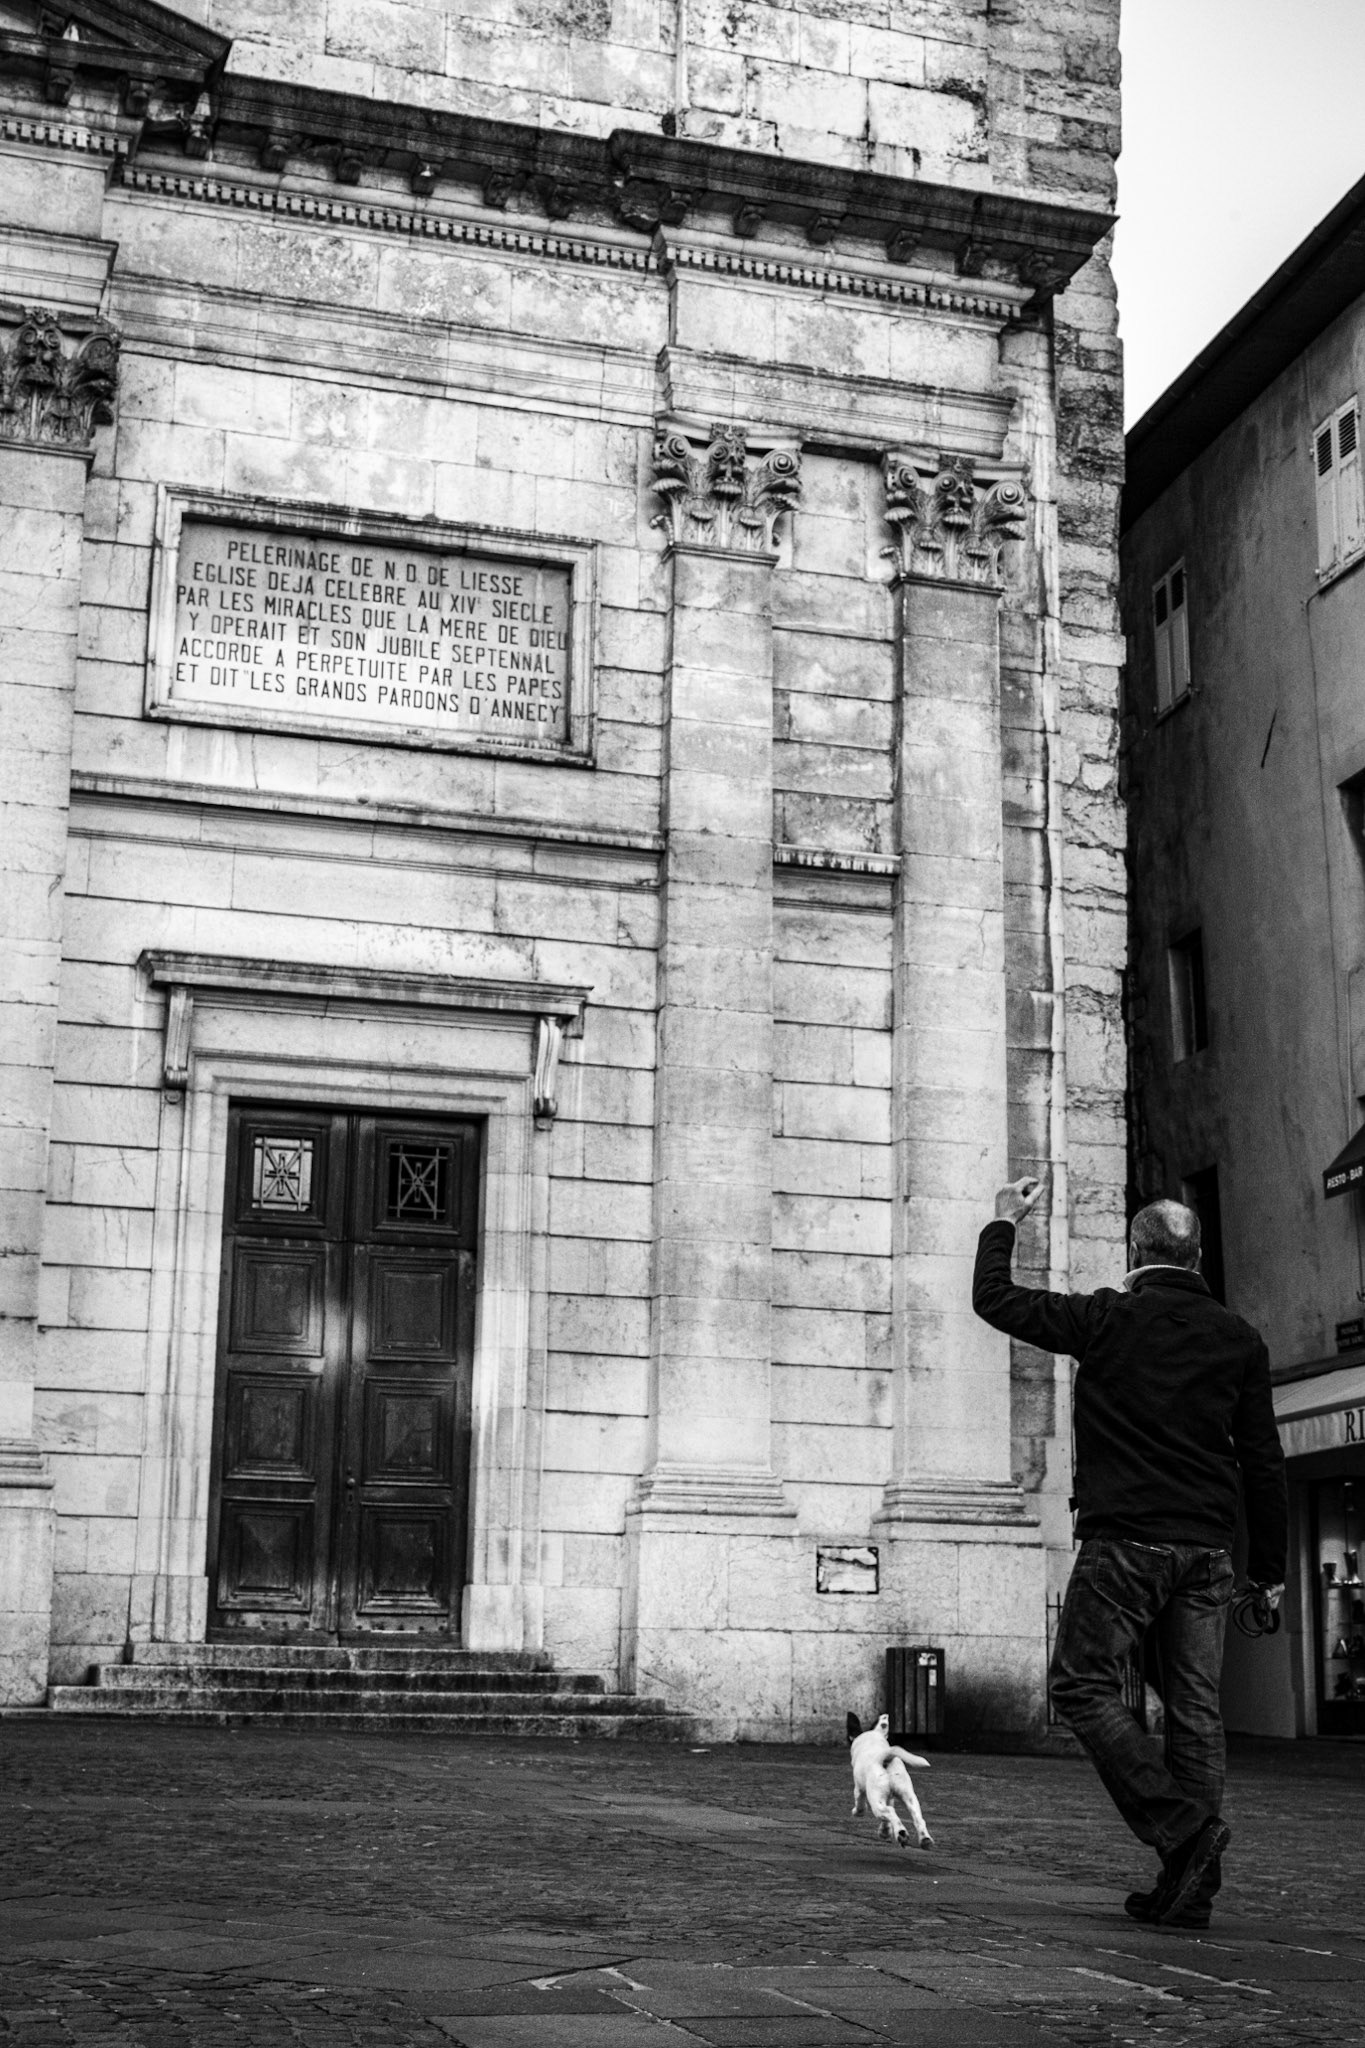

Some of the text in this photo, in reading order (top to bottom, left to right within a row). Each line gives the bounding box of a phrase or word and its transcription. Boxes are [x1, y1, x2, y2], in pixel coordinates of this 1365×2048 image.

[194, 562, 256, 587] EGLISE
[268, 572, 314, 595] DEJA
[325, 578, 406, 606] CELEBRE
[418, 590, 439, 610] AU
[492, 600, 553, 624] SIECLE
[227, 541, 341, 573] PELERINAGE
[352, 557, 373, 577] DE
[428, 566, 449, 587] DE
[461, 570, 523, 596] LIESSE
[176, 585, 567, 650] PAR LES MIRACLES QUE LA MERE DE DIEU
[189, 611, 554, 674] Y OPERAIT ET SON JUBILE SEPTENNAL
[176, 662, 198, 683] ET
[211, 666, 238, 687] DIT
[297, 677, 366, 702] GRANDS
[378, 686, 459, 713] PARDONS
[179, 637, 562, 699] ACCORDE A PERPETUITE PAR LES PAPES
